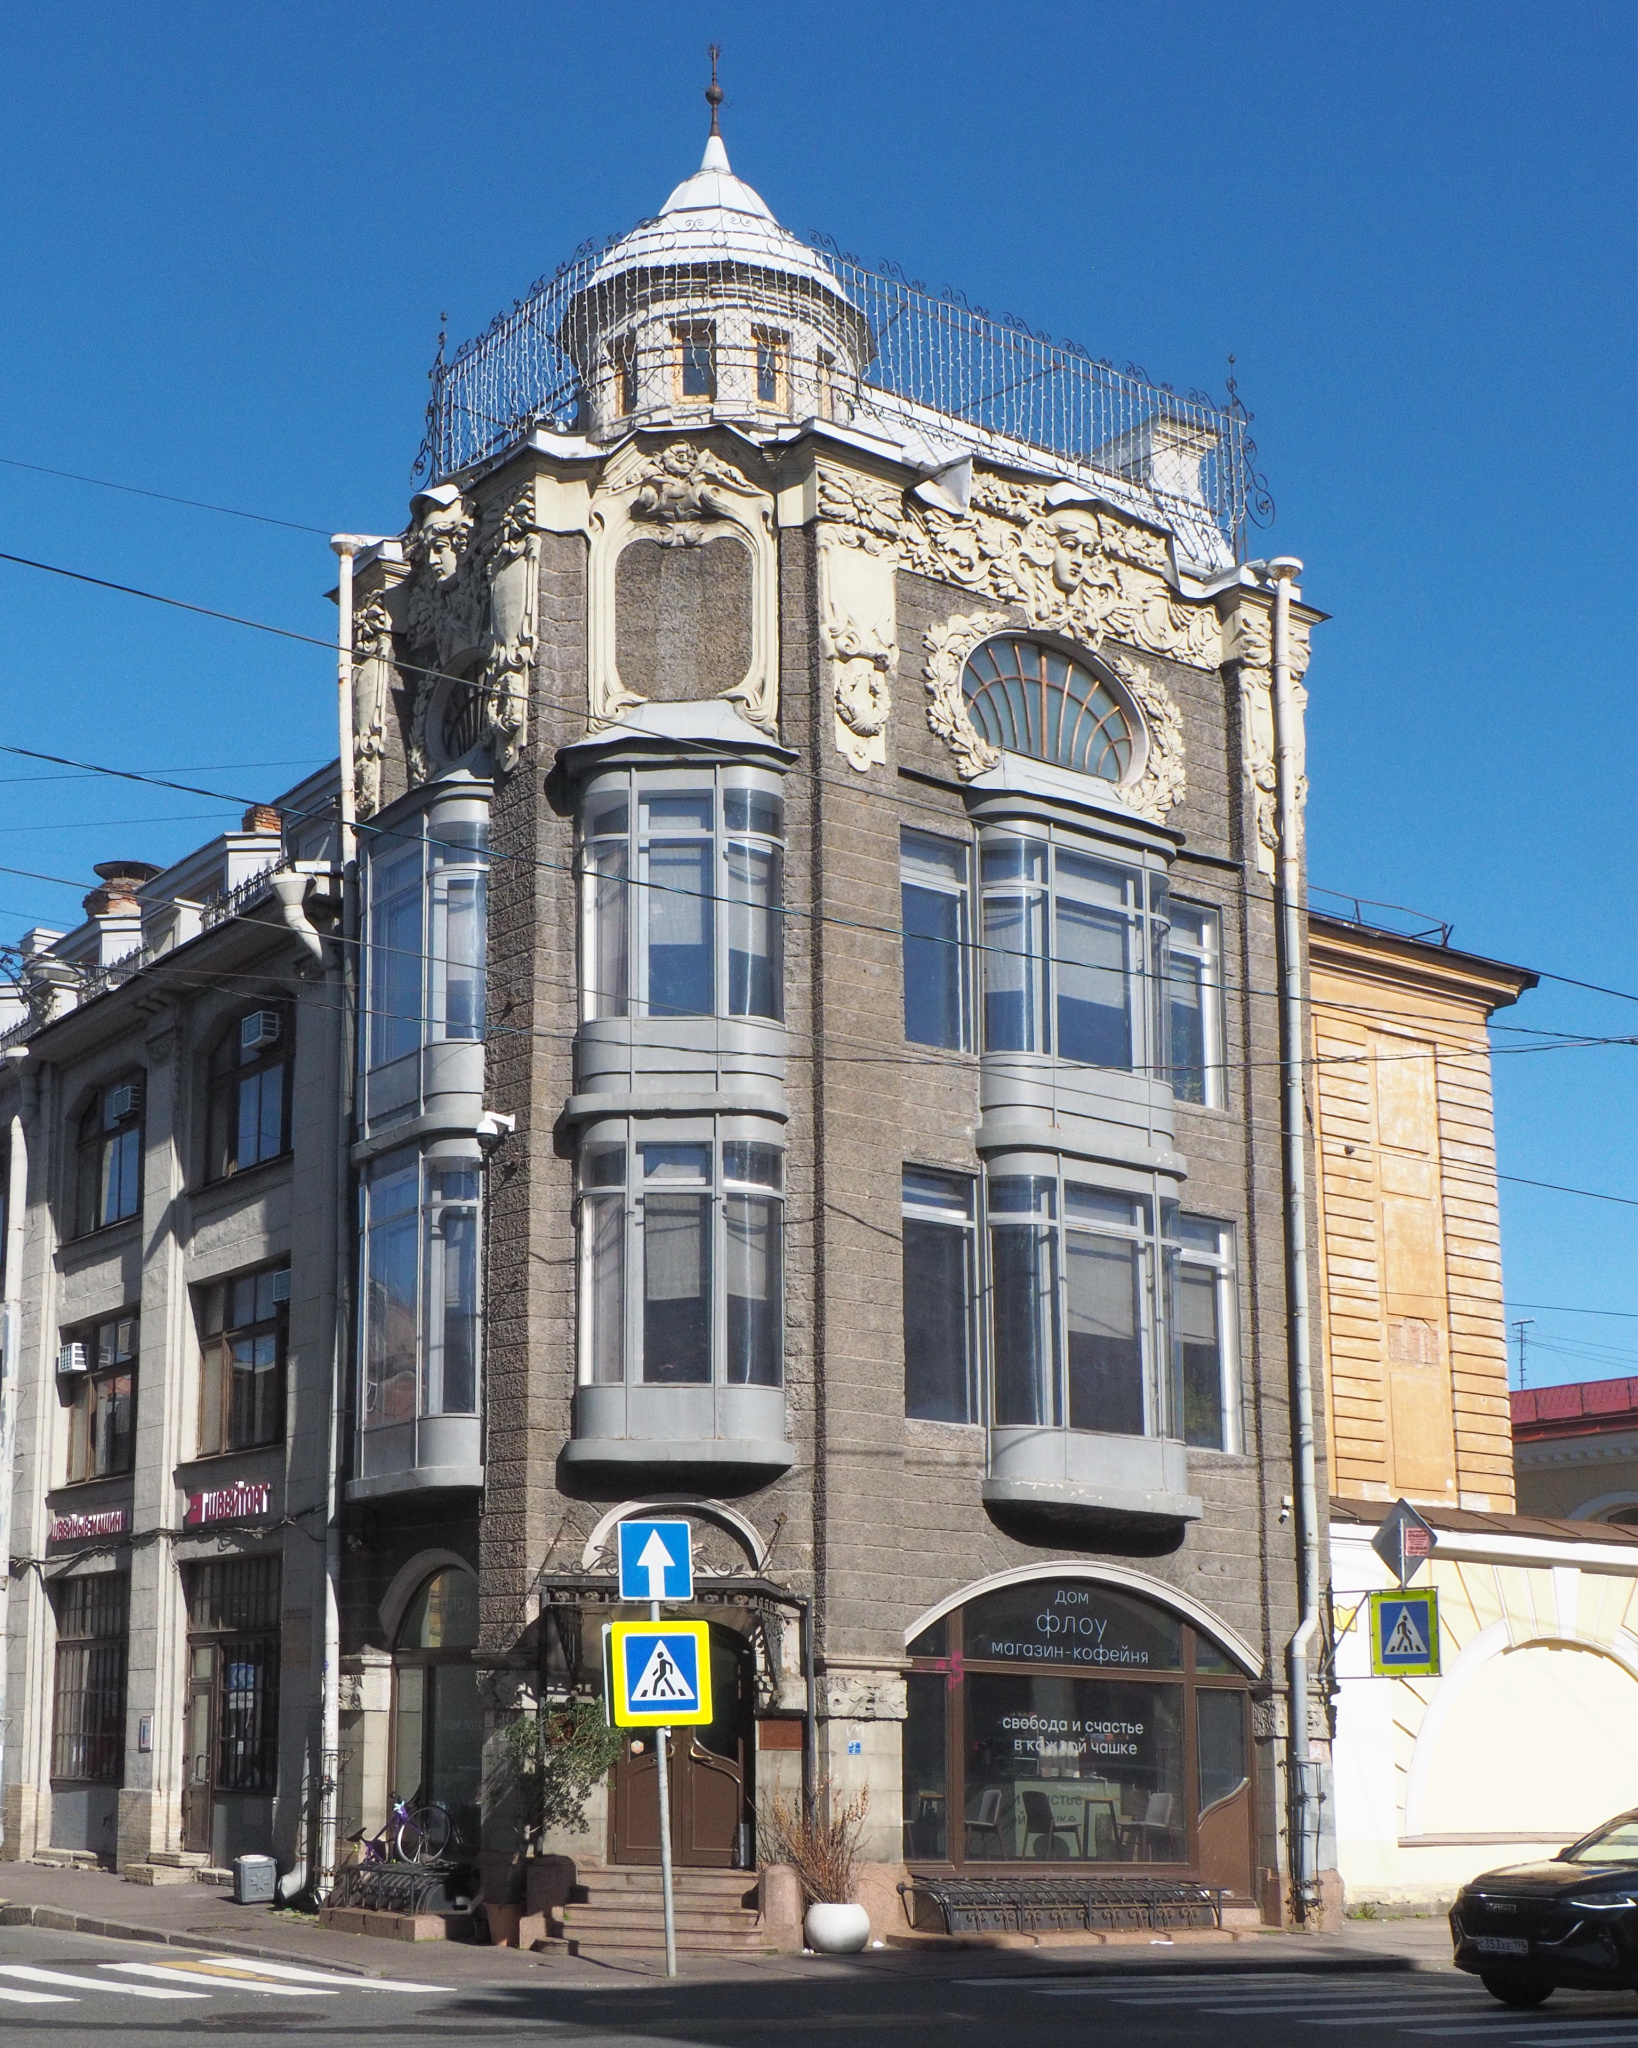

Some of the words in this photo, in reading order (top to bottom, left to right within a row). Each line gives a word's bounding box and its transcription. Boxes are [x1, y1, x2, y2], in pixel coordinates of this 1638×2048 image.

[207, 1481, 270, 1519] ШВЕЙТОРГ
[51, 1513, 91, 1540] ШВЕЙНЫЕ
[1054, 1590, 1089, 1605] дом
[1036, 1608, 1108, 1643] флоу
[991, 1641, 1149, 1664] магазин-кофейня
[1002, 1715, 1068, 1733] свобода
[1072, 1720, 1081, 1732] и
[1085, 1721, 1144, 1734] счастье
[1014, 1739, 1022, 1751] в
[1090, 1742, 1138, 1755] чашке
